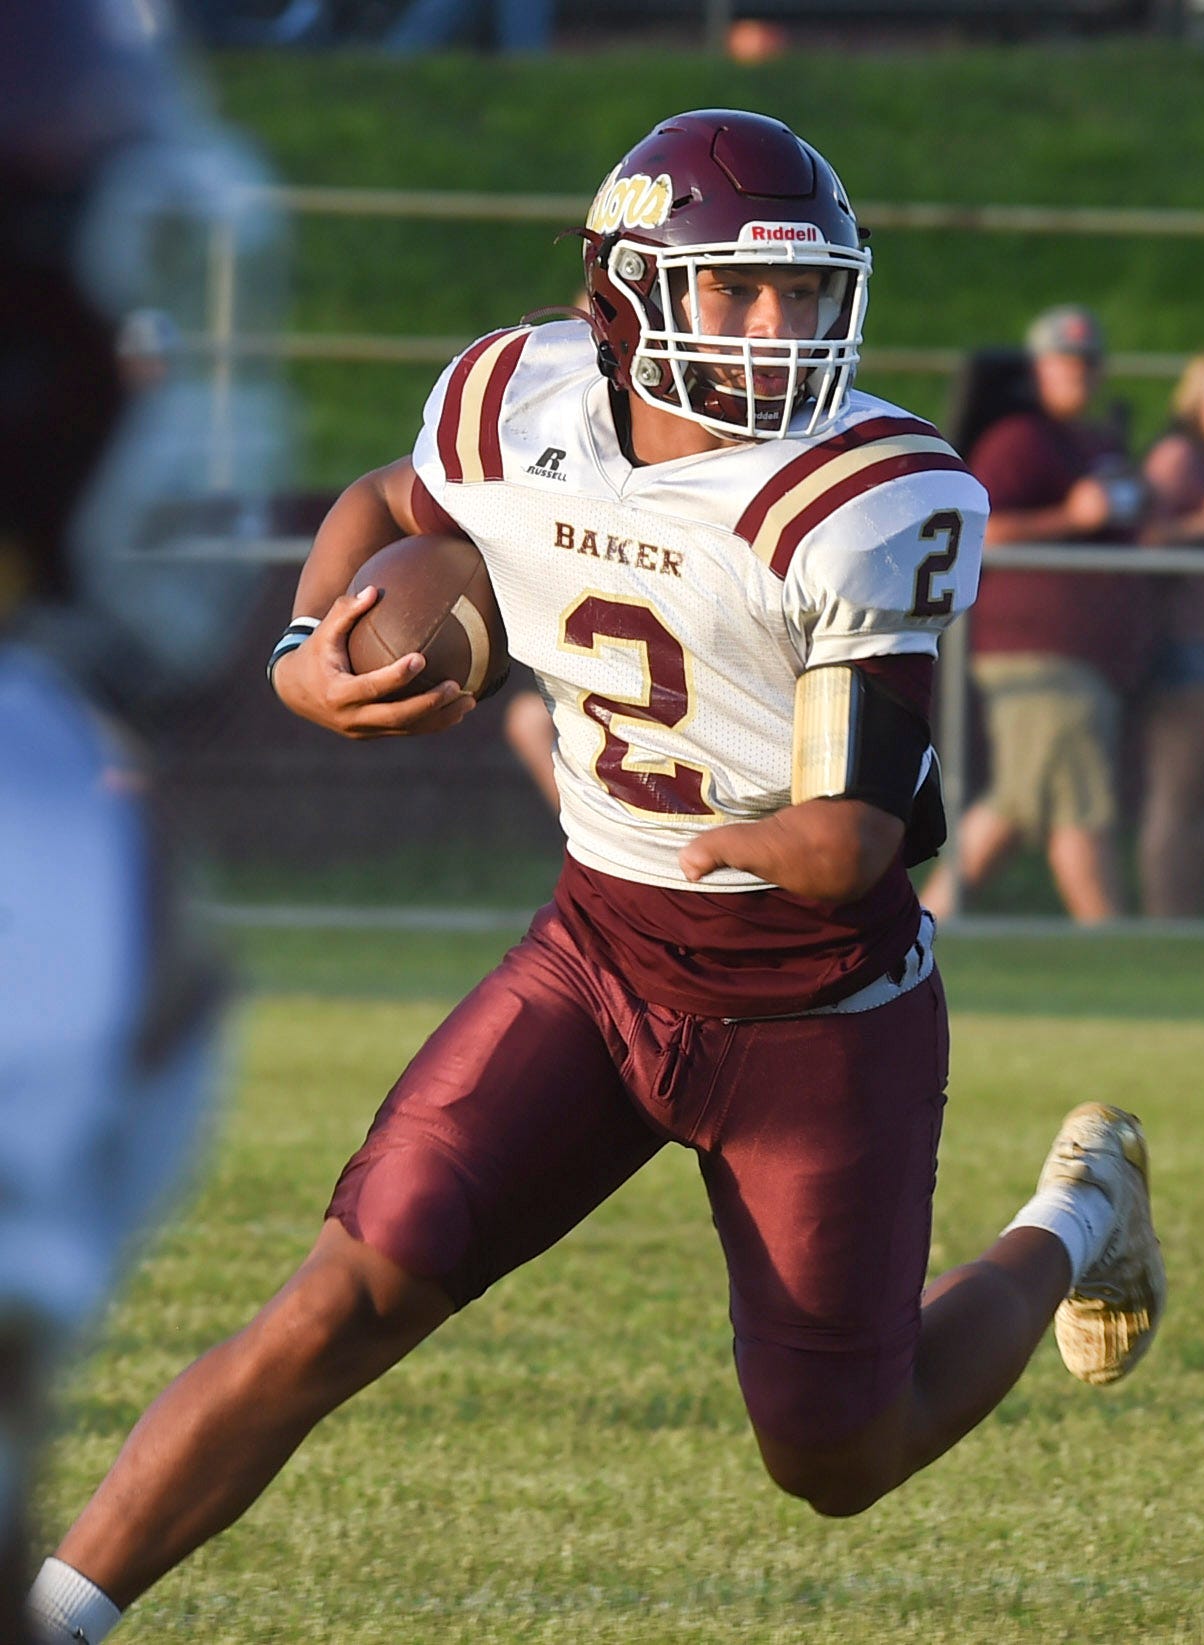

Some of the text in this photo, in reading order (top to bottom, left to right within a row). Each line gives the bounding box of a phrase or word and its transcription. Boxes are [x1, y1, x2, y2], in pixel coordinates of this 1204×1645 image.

[751, 226, 817, 242] Riddell
[526, 465, 567, 482] RUSSELL
[554, 521, 684, 578] BAKER
[903, 508, 964, 620] 2
[557, 587, 725, 823] 2
